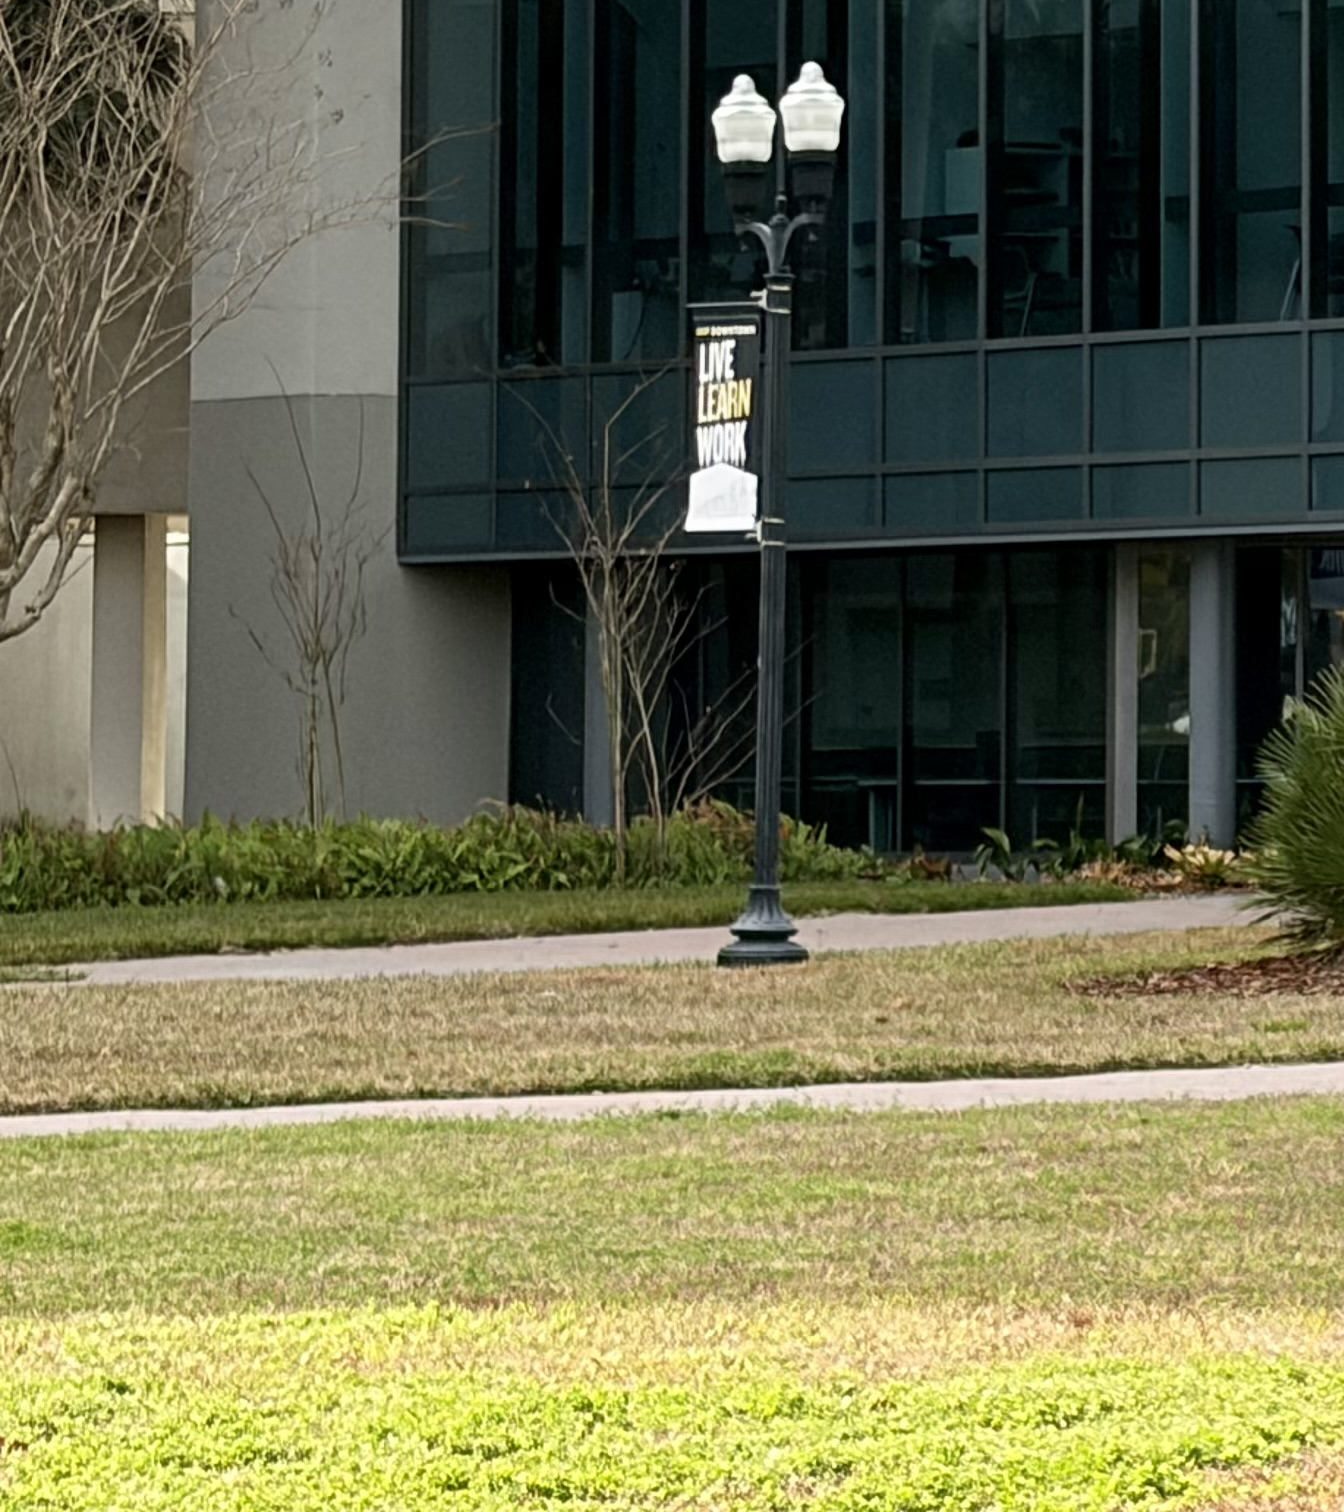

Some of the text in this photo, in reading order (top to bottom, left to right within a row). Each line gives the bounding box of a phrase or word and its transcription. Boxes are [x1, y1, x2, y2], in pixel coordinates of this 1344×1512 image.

[699, 339, 736, 381] LIVE
[697, 378, 752, 423] LEARN
[696, 420, 748, 466] WORK
